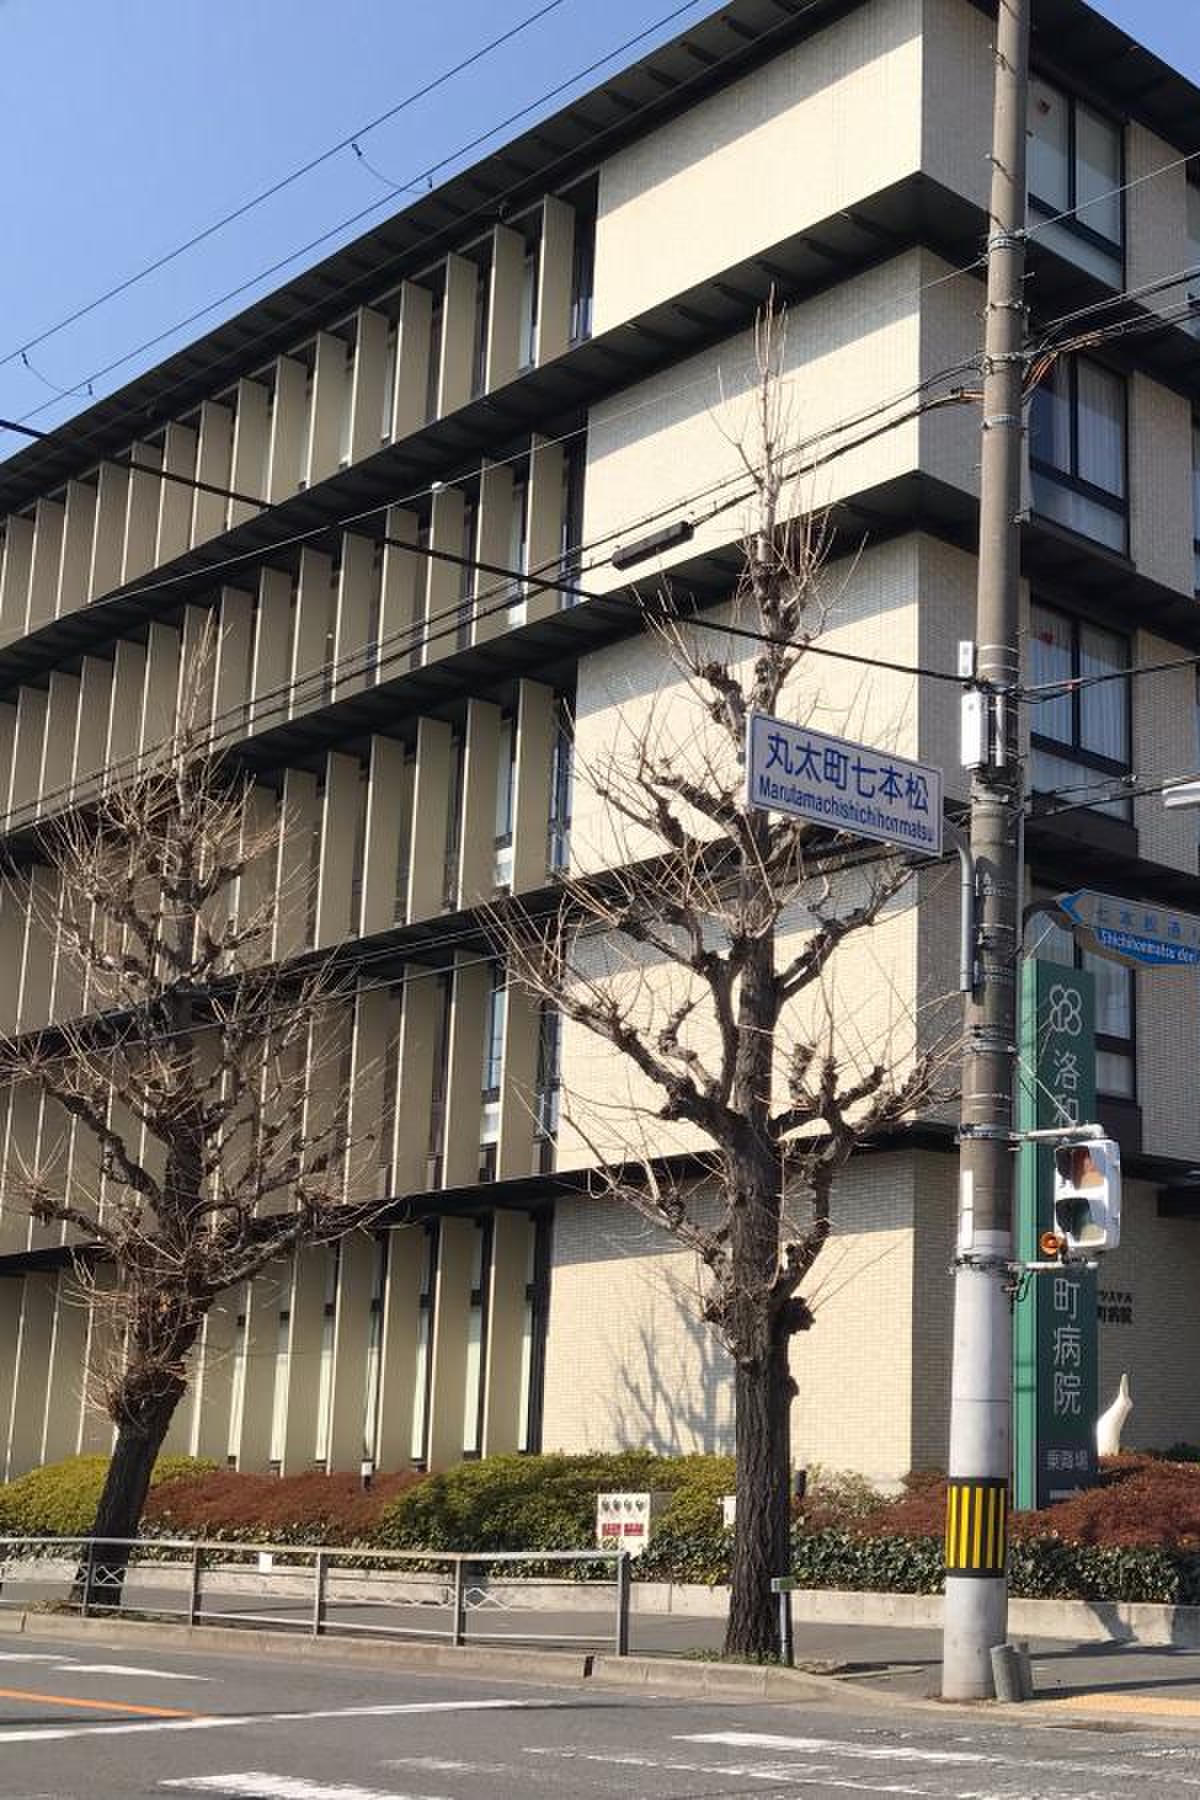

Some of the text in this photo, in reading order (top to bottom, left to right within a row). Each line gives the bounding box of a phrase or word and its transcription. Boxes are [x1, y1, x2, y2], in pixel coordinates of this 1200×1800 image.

[759, 774, 935, 843] Marutamachishichihonmatsu
[765, 731, 930, 816] 丸太町七本松
